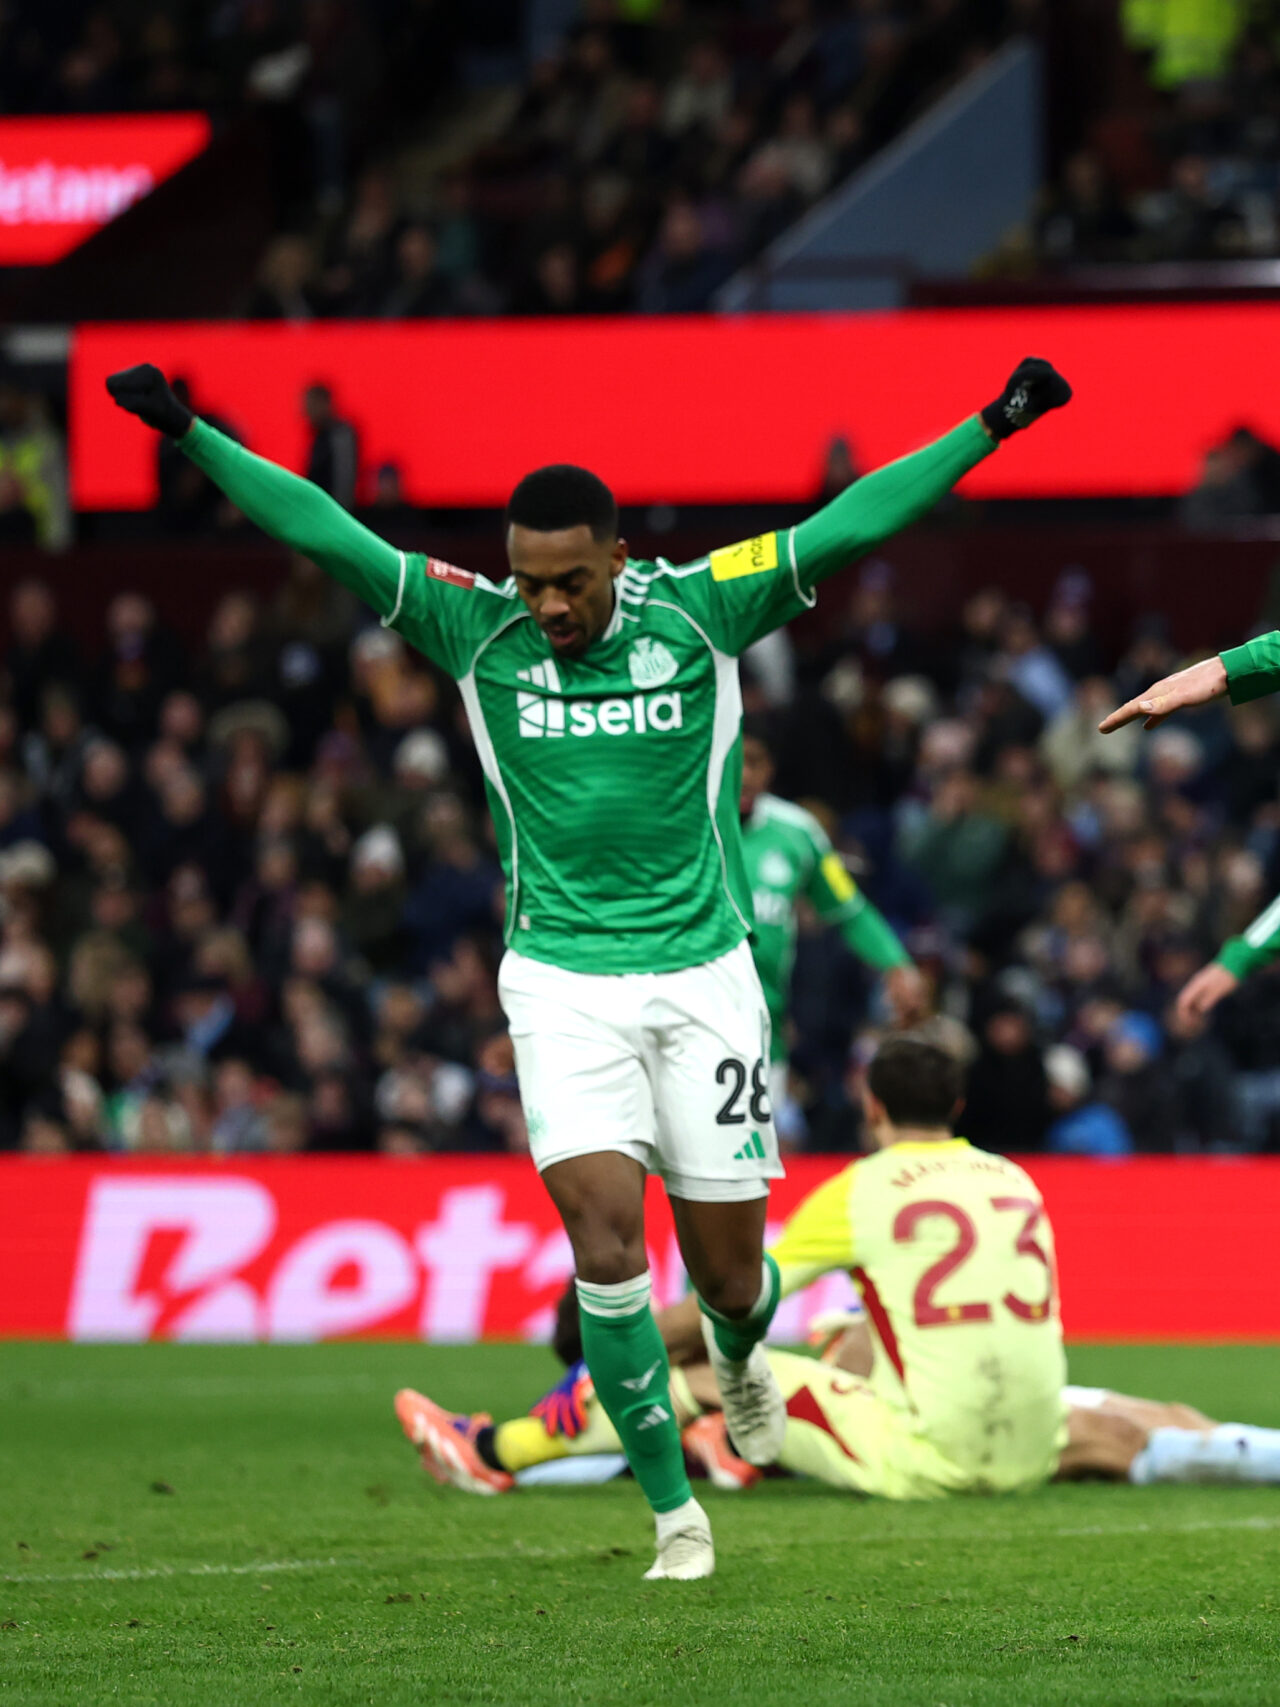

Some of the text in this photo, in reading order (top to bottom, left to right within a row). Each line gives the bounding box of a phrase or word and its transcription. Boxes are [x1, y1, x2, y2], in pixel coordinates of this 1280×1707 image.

[569, 691, 683, 738] sela
[715, 1057, 771, 1126] 28
[891, 1195, 1052, 1330] 23
